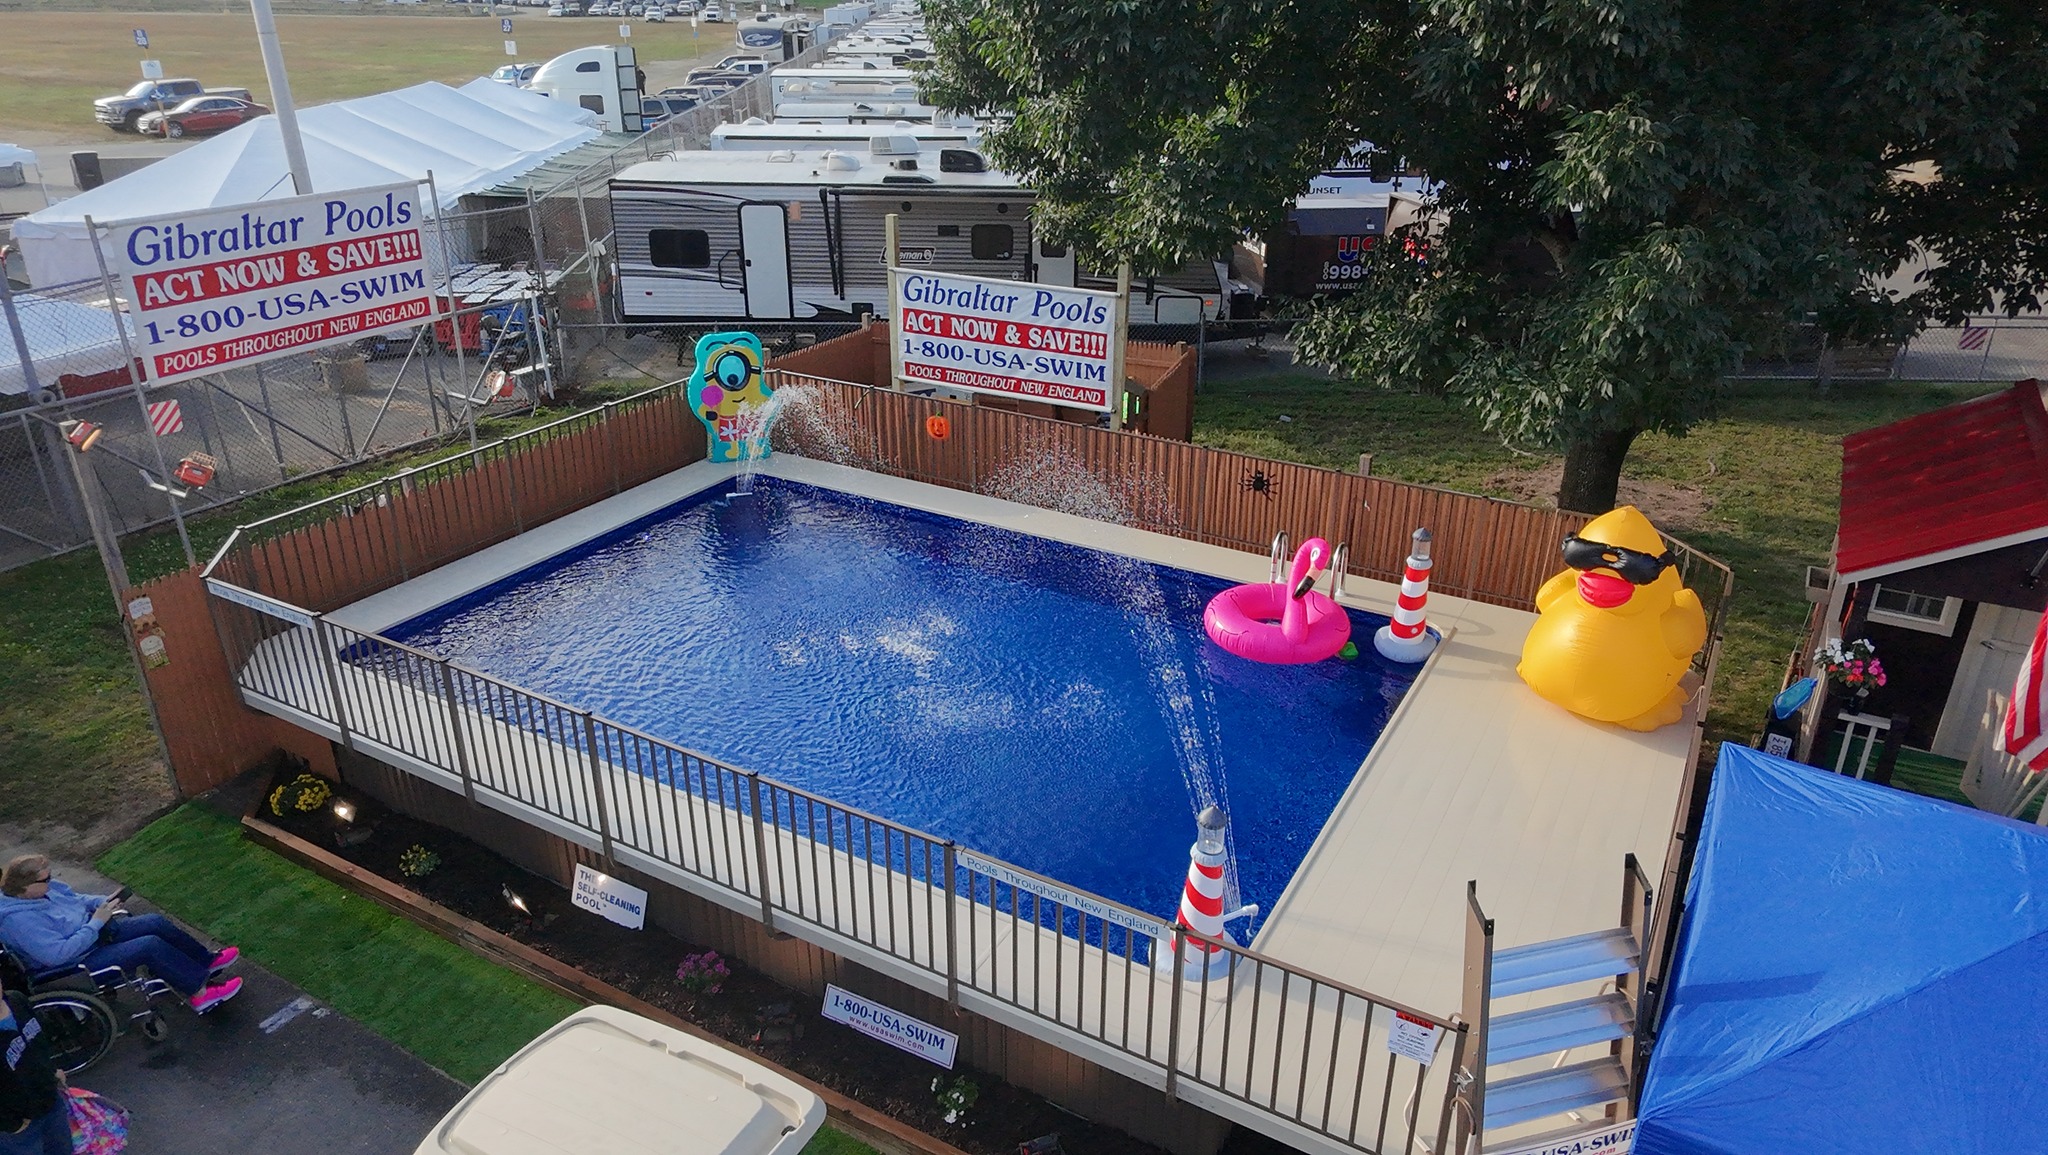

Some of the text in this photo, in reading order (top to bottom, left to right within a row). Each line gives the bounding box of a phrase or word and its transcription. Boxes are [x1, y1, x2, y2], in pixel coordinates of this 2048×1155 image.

[1308, 186, 1342, 195] UNSET
[127, 192, 411, 266] Gibraltar Pools
[144, 232, 420, 307] ACT NOW & SAVE!!!
[144, 268, 425, 345] 1-800-USA-SWIM
[903, 275, 1107, 324] Gibraltar Pools
[163, 301, 425, 374] POOLS THROUGHOUT NEW ENGLAND
[905, 311, 1105, 357] ACT NOW & SAVE!!!
[904, 338, 1106, 382] 1-800-USA-SWIM
[909, 364, 1101, 403] POOLS THROUGHOUT NEW ENGLAND
[576, 892, 601, 911] POOL
[577, 881, 641, 916] SELF-CLEANING
[966, 857, 1159, 936] Pools Throughout New England
[833, 995, 946, 1050] 1-800-USA-SWIM
[849, 1016, 925, 1052] www.usaswim.com
